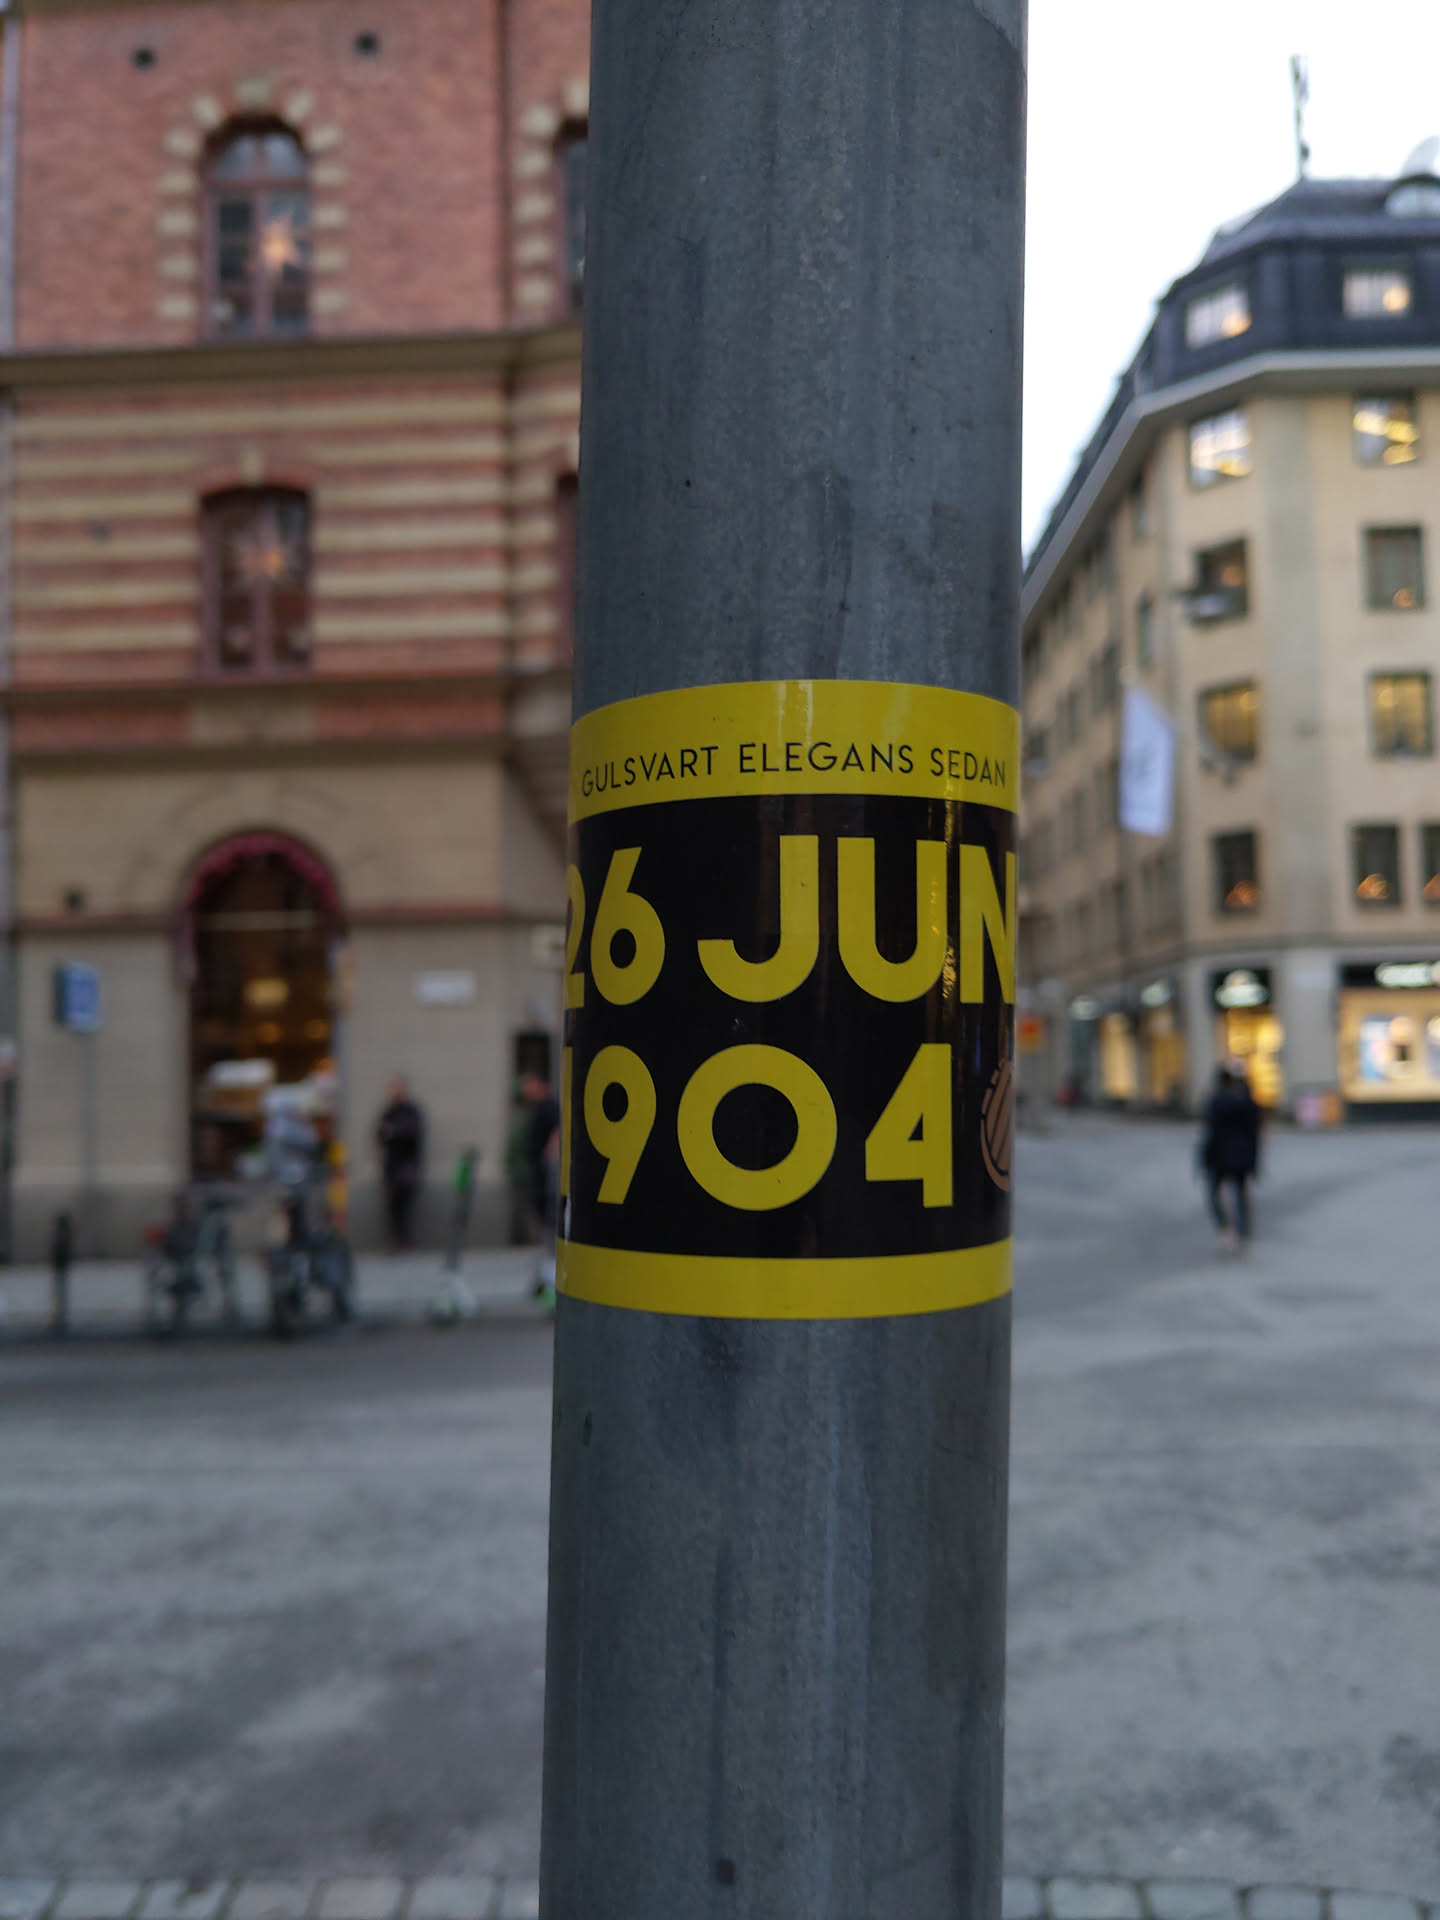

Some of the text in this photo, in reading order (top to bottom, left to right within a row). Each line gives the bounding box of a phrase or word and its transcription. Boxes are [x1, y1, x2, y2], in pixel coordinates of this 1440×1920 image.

[582, 741, 1006, 797] GULSVART ELEGANS SEDAN
